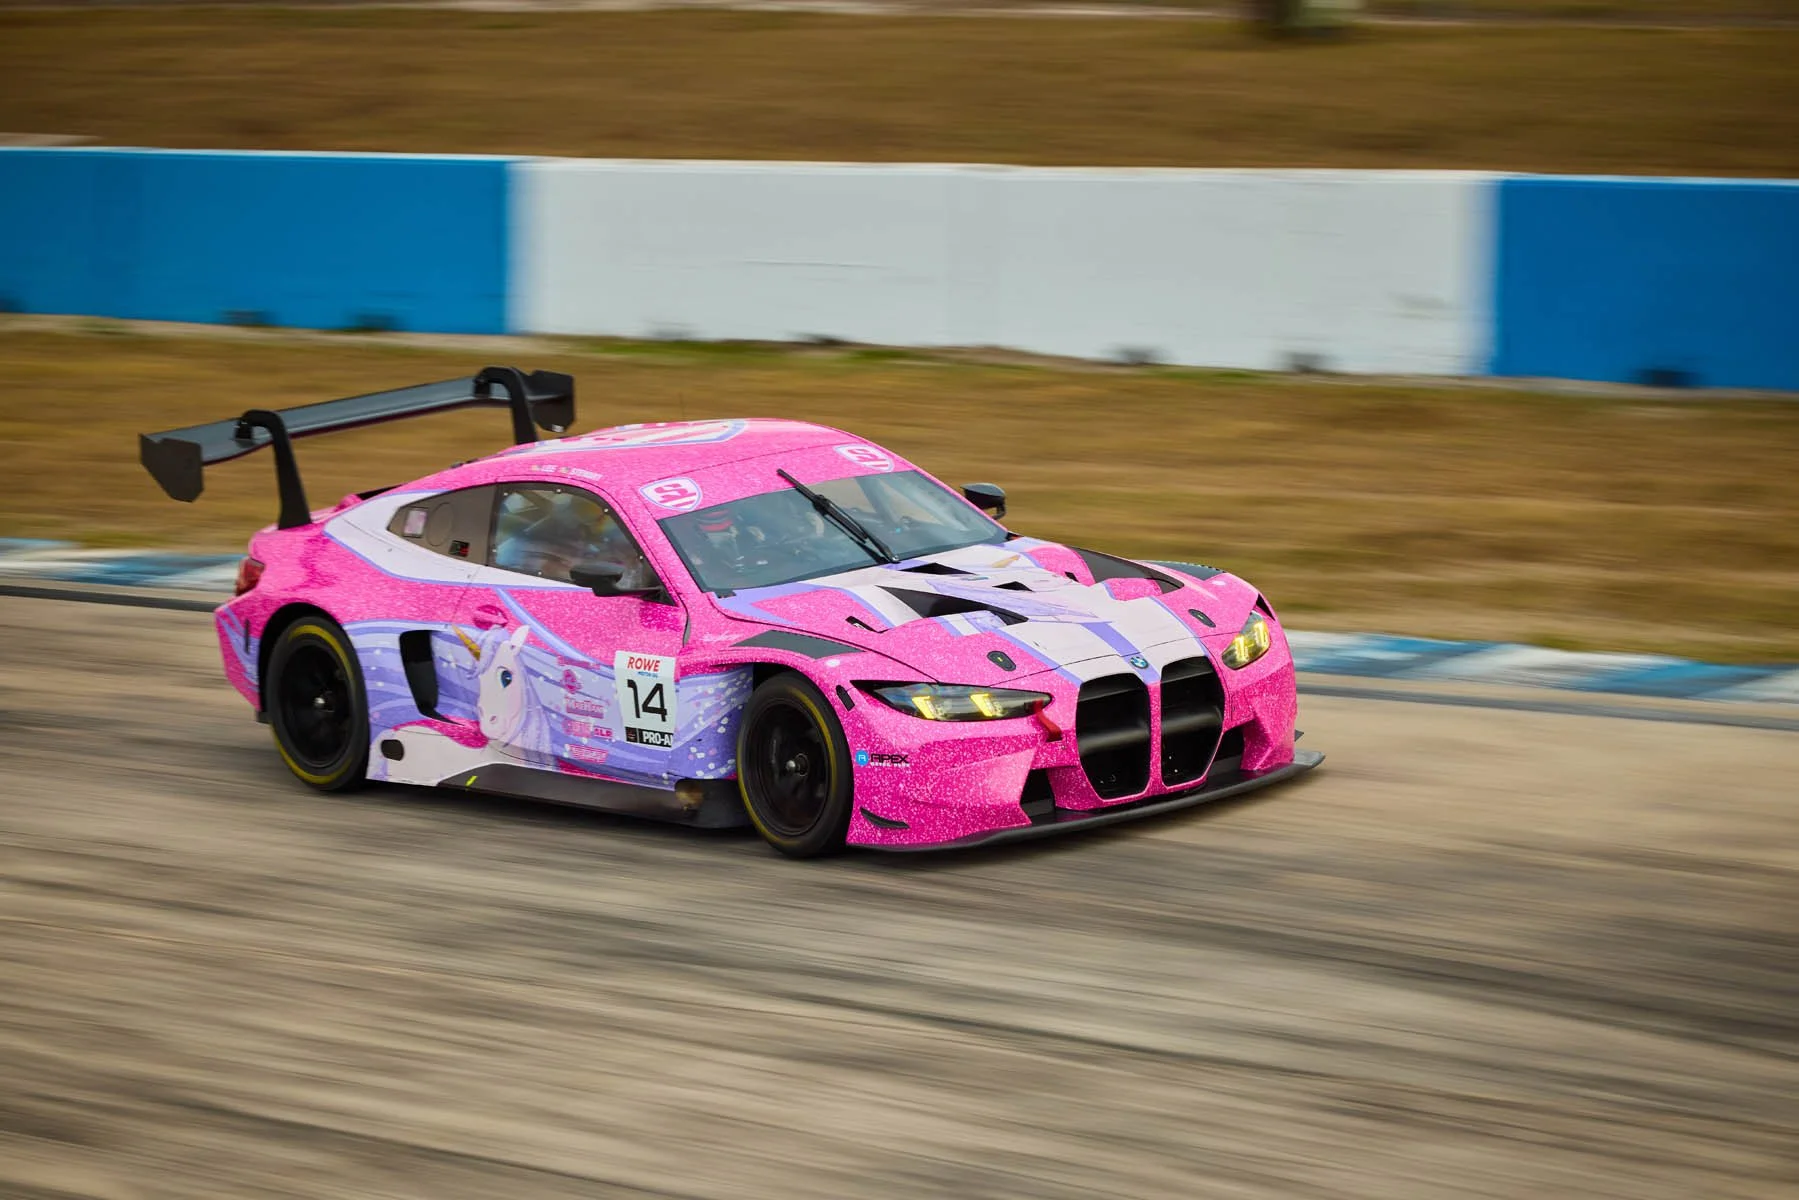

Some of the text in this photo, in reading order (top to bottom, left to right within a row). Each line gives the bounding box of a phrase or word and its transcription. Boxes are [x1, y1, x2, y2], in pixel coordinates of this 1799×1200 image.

[627, 656, 661, 672] ROWE
[627, 679, 668, 722] 14
[871, 753, 910, 763] APEX
